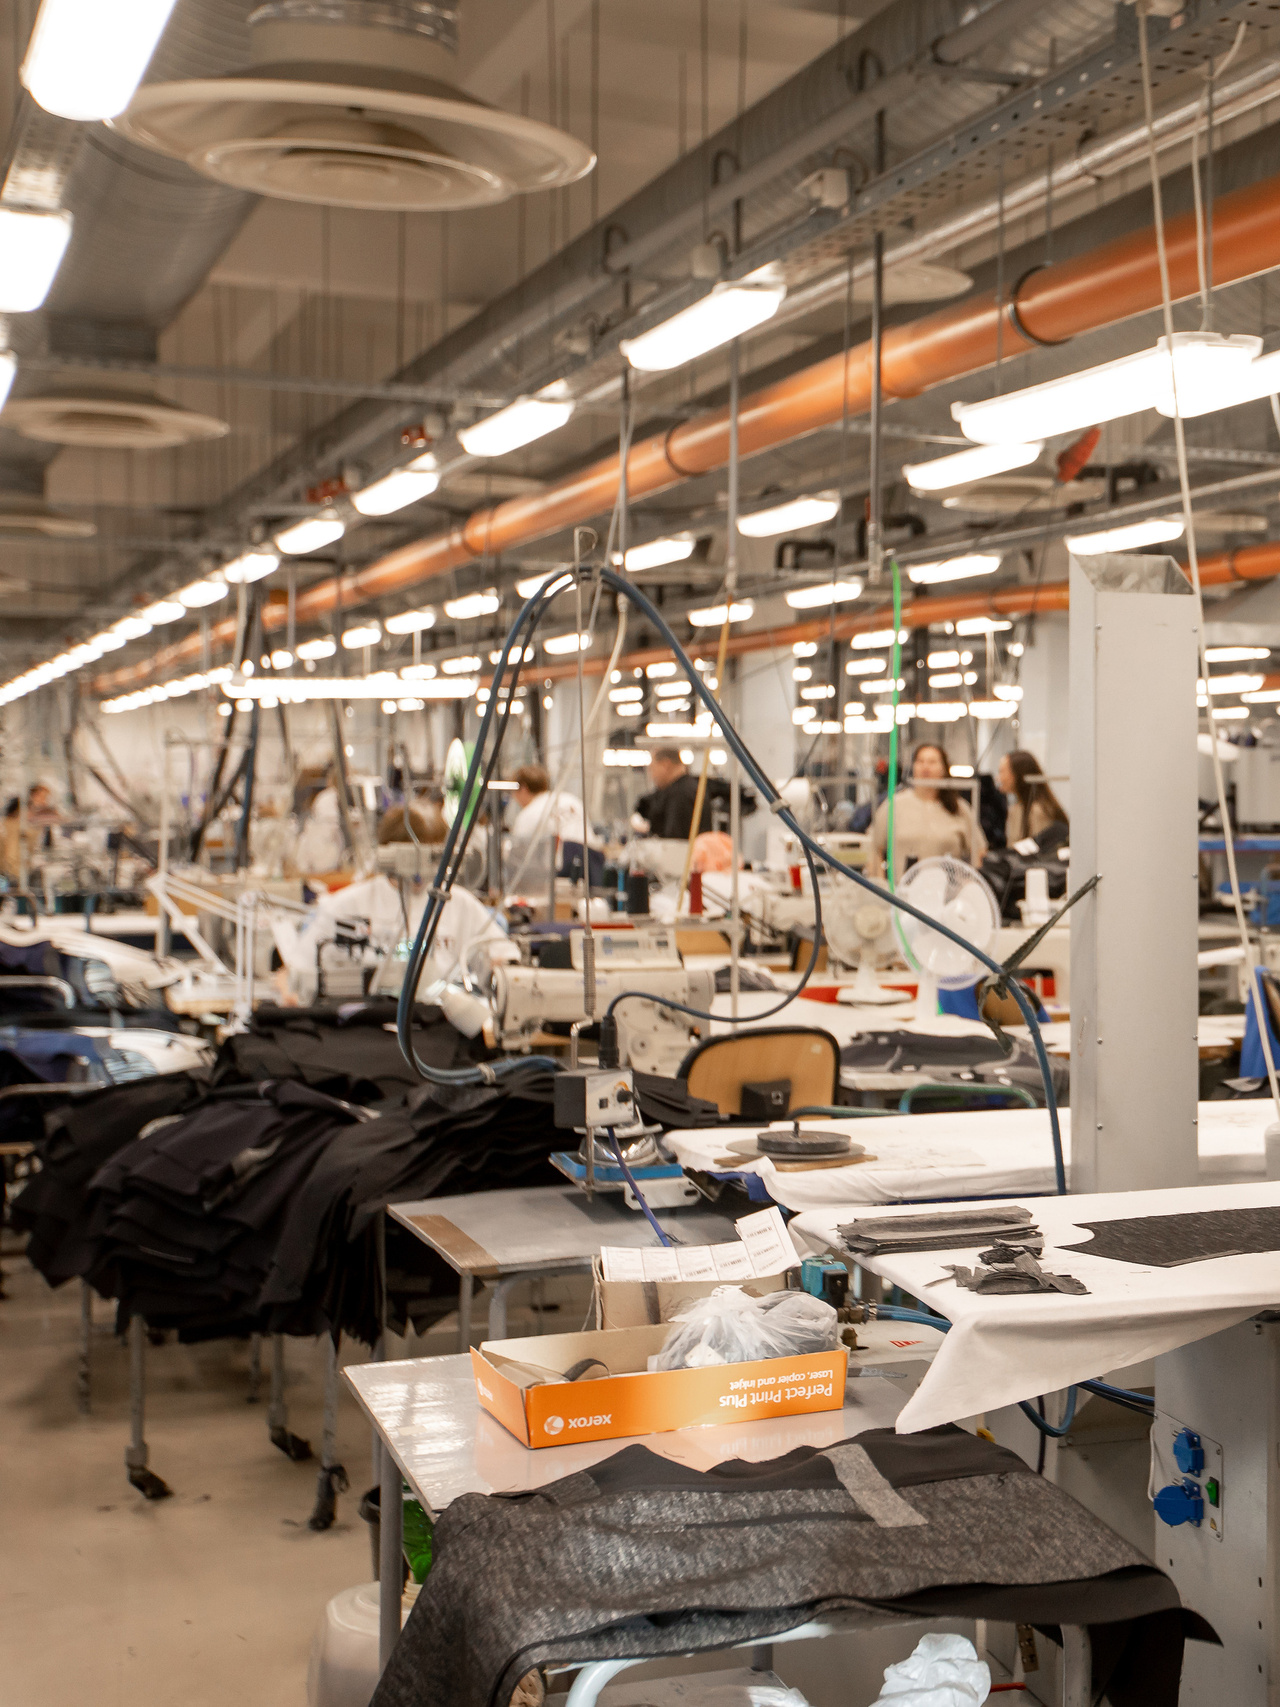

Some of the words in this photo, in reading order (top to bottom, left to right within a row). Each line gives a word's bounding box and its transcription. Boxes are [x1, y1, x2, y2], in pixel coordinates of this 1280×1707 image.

[777, 1372, 806, 1384] copier
[807, 1369, 833, 1380] Laser,
[729, 1378, 755, 1391] inkjet
[757, 1376, 776, 1388] and
[750, 1389, 781, 1405] Print
[785, 1383, 833, 1400] Perfect
[719, 1393, 748, 1408] Plus
[568, 1413, 612, 1429] xerox
